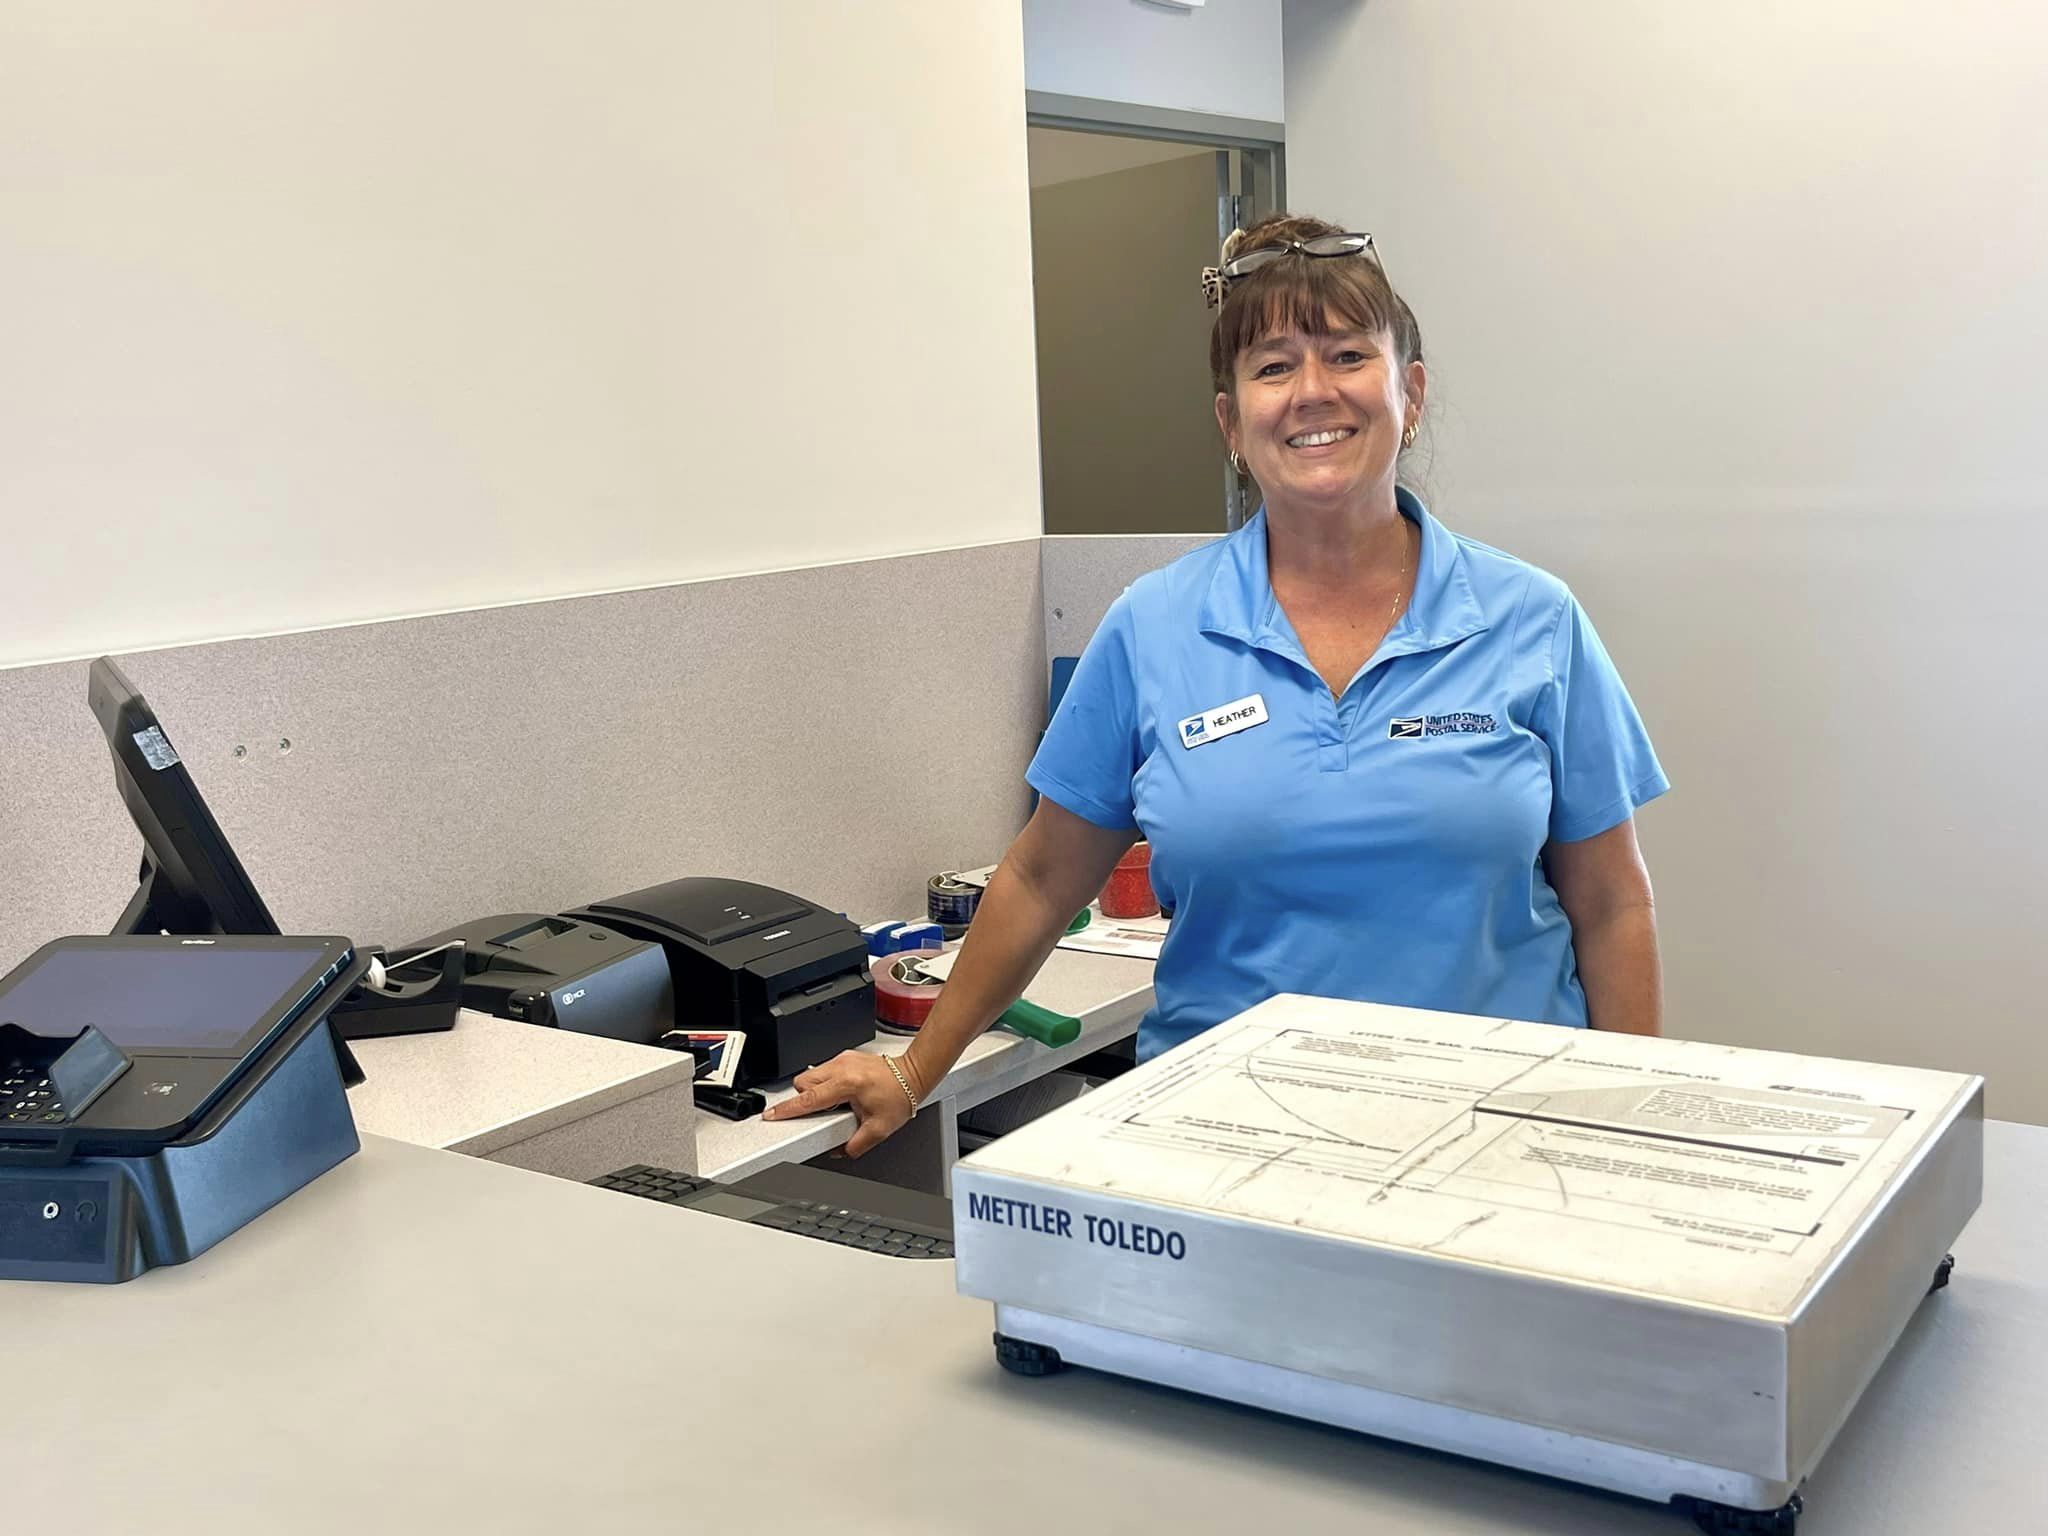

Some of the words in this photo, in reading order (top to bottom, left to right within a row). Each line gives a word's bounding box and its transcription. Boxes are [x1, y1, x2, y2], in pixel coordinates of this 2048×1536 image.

[1212, 705, 1257, 728] HEATHER
[1425, 712, 1460, 726] UNITED
[1461, 712, 1493, 723] STATES
[1425, 723, 1459, 737] POSTAL
[1460, 722, 1497, 734] SERVICE
[969, 1191, 1073, 1239] METTLER
[1083, 1213, 1187, 1261] TOLEDO
